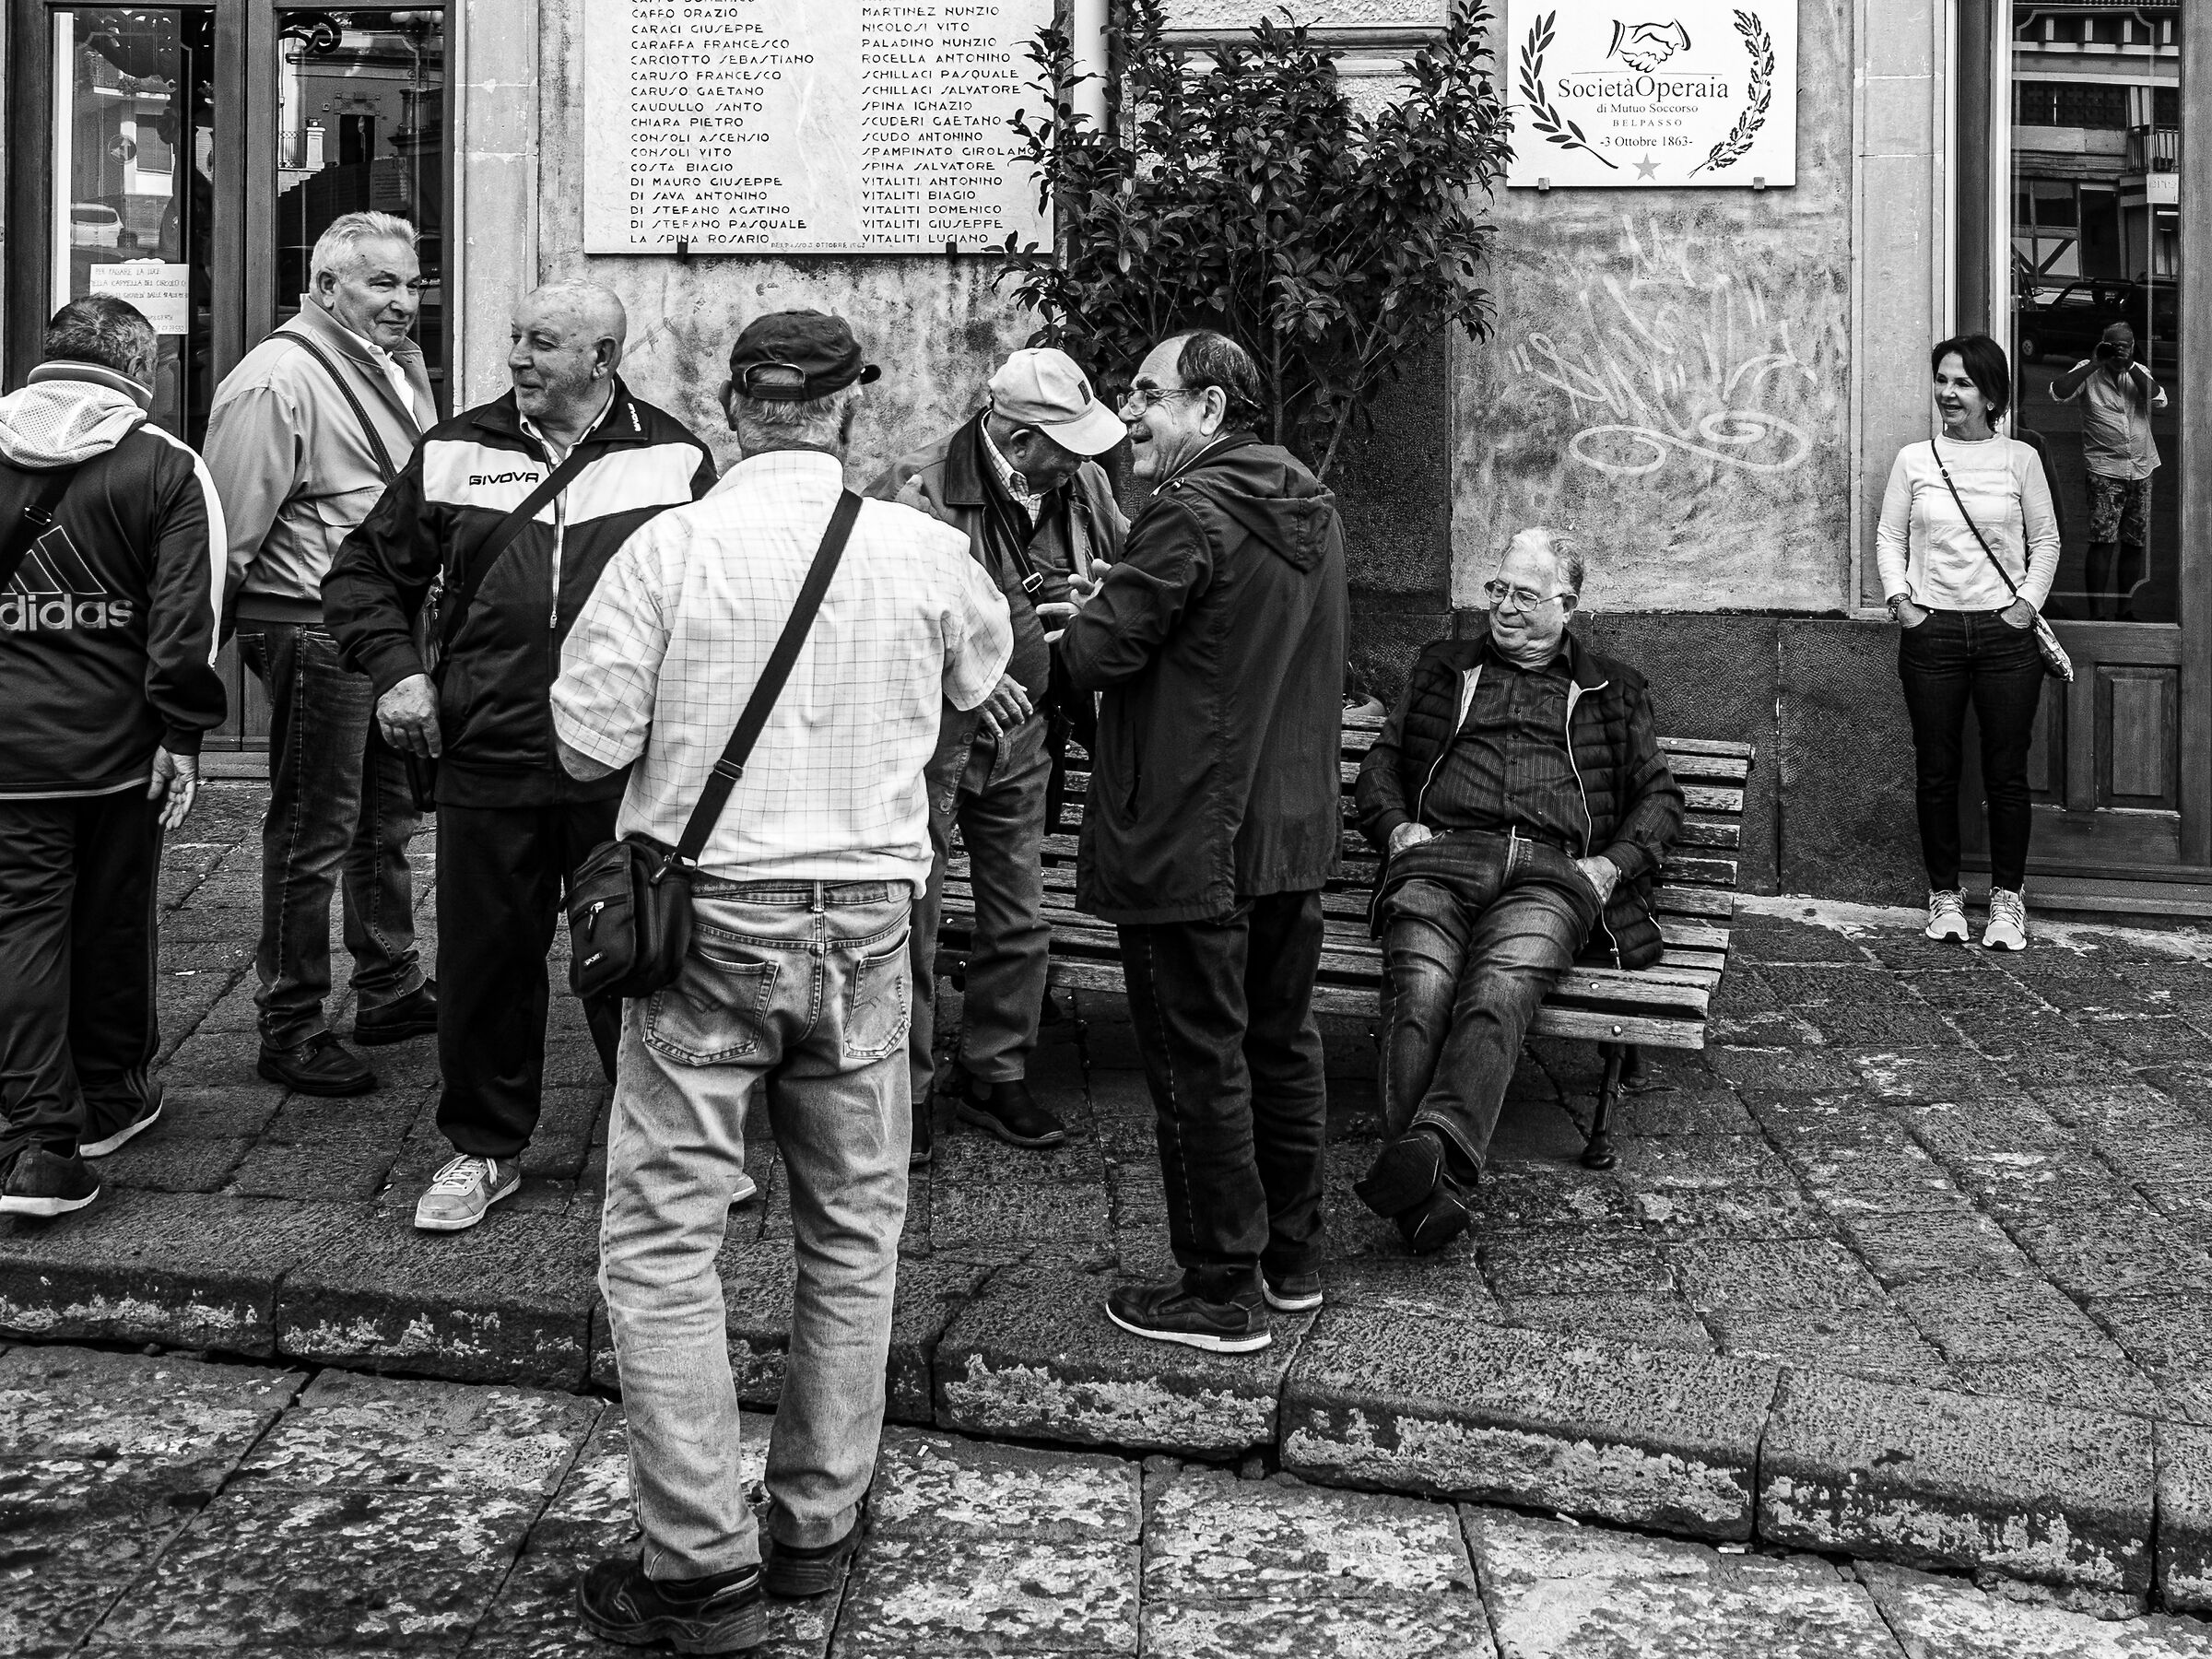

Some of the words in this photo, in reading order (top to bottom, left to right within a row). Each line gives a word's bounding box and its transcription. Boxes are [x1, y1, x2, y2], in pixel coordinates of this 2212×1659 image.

[631, 8, 675, 18] CAFFO
[683, 7, 738, 18] ORAZIO
[862, 6, 936, 17] MARTINEZ
[945, 6, 1000, 17] NUNZIO
[631, 24, 681, 35] CARACI
[690, 23, 764, 34] GIUSEPPE
[862, 22, 927, 32] NICOLOSI
[936, 22, 970, 32] VITO
[631, 40, 694, 50] CARAFFA
[703, 39, 790, 49] FRANCESCO
[862, 38, 934, 48] PALADINO
[942, 37, 997, 48] NUNZIO
[630, 54, 711, 65] CARCIOTTO
[719, 54, 815, 65] SEBASTIANO
[862, 53, 926, 64] ROCELLA
[935, 53, 1011, 64] ANTONINO
[630, 70, 688, 81] CARUSO
[696, 70, 782, 81] FRANCESCO
[862, 70, 932, 79] SCHILLACI
[940, 69, 1019, 80] PASQUALE
[630, 87, 688, 97] CARUSO
[696, 86, 764, 97] GAETANO
[862, 85, 932, 95] SCHILLACI
[940, 85, 1021, 95] SALVATORE
[630, 102, 704, 112] CAUDULLO
[714, 101, 763, 112] SANTO
[861, 100, 905, 112] SPINA
[913, 100, 972, 112] IGNAZIO
[1596, 103, 1607, 113] di
[1610, 103, 1646, 113] Mutuo
[1649, 103, 1699, 113] Soccorso
[630, 117, 680, 127] CHIARA
[689, 117, 744, 127] PIETRO
[861, 115, 924, 127] SCUDERI
[933, 115, 1002, 127] GAETANO
[1612, 119, 1682, 127] BELPASSO
[630, 133, 690, 143] CONSOLI
[699, 133, 770, 143] ASCENSIO
[861, 132, 910, 142] SCUDO
[918, 132, 983, 142] ANTONINO
[1614, 135, 1657, 147] Ottobre
[630, 147, 689, 158] CONSOLI
[699, 147, 732, 158] VITO
[862, 147, 953, 157] SPAMPINATO
[961, 147, 1036, 157] GIROLAMO
[630, 162, 675, 172] COSTA
[686, 162, 734, 172] BIAGIO
[862, 162, 904, 171] SPINA
[913, 161, 995, 171] SALVATORE
[630, 177, 644, 187] DI
[653, 177, 701, 187] MAURO
[710, 177, 782, 187] GIUSEPPE
[862, 176, 921, 186] VITALITI
[929, 176, 1003, 186] ANTONINO
[630, 191, 644, 201] DI
[653, 191, 685, 201] SAVA
[695, 191, 768, 201] ANTONINO
[862, 191, 920, 201] VITALITI
[928, 190, 976, 200] BIAGIO
[629, 206, 643, 215] DI
[652, 206, 720, 215] STEFANO
[728, 206, 790, 215] AGATINO
[862, 206, 920, 215] VITALITI
[928, 205, 1002, 215] DOMENICO
[630, 219, 643, 229] DI
[652, 219, 721, 229] STEFANO
[728, 219, 807, 229] PASQUALE
[862, 219, 920, 229] VITALITI
[928, 218, 1004, 229] GIUSEPPE
[630, 234, 647, 243] LA
[656, 234, 700, 244] SPINA
[708, 233, 770, 244] ROSARIO
[862, 233, 921, 243] VITALITI
[928, 233, 989, 244] LUCIANO
[468, 471, 539, 487] GIVOVA
